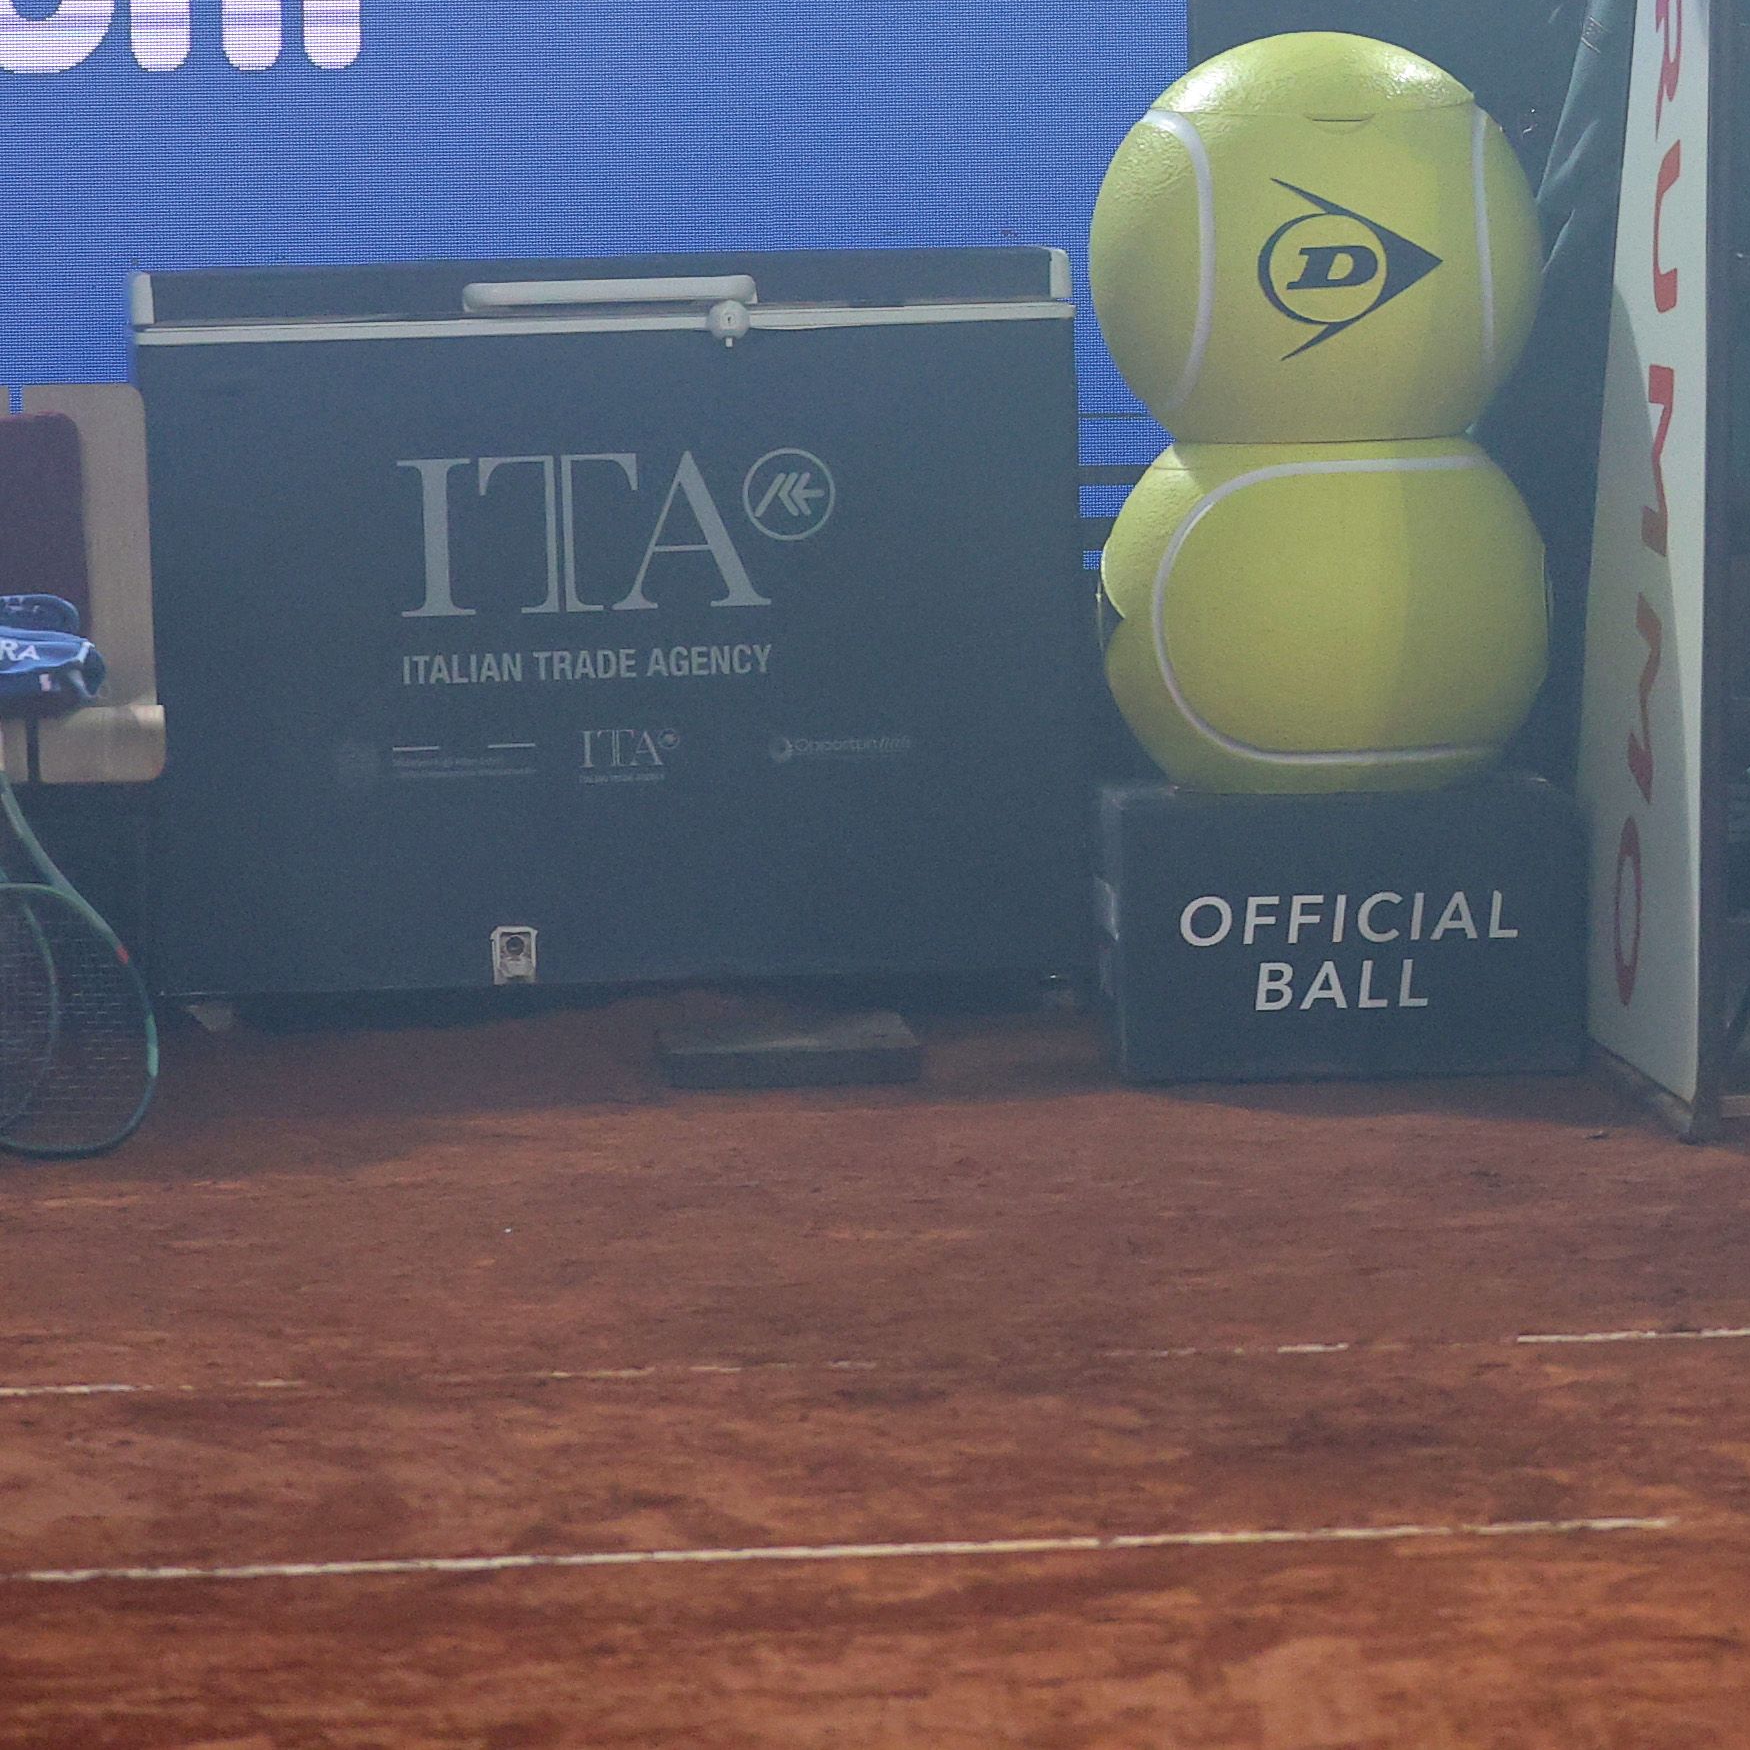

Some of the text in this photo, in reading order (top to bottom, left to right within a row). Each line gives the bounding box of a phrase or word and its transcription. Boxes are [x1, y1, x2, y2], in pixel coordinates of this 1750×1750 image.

[396, 450, 772, 619] ITA
[402, 644, 772, 687] ITALIAN TRADE AGENCY
[578, 729, 664, 768] ITA
[1179, 889, 1520, 948] OFFICIAL
[1254, 958, 1432, 1013] BALL
